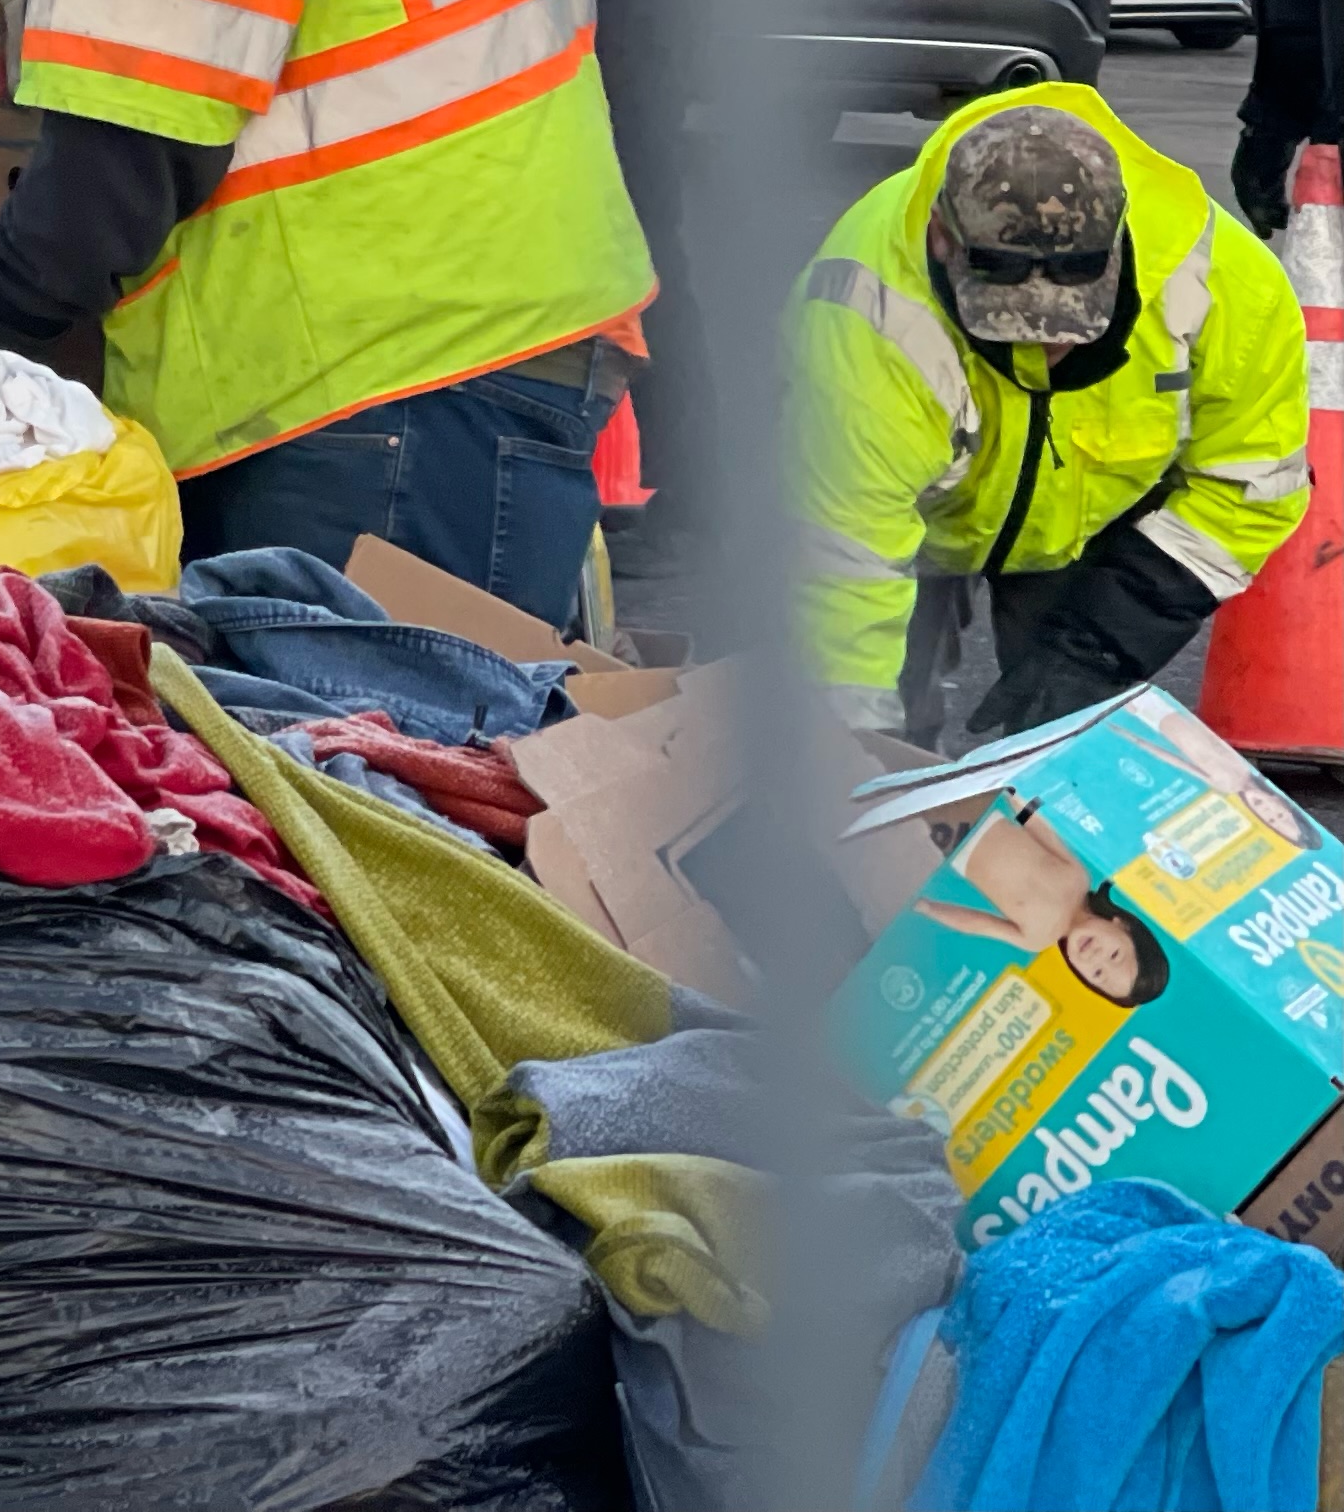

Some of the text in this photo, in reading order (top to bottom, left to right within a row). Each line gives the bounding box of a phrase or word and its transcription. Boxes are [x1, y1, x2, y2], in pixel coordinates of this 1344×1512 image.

[927, 979, 1026, 1095] skin protection
[951, 1027, 1077, 1167] swaddlers
